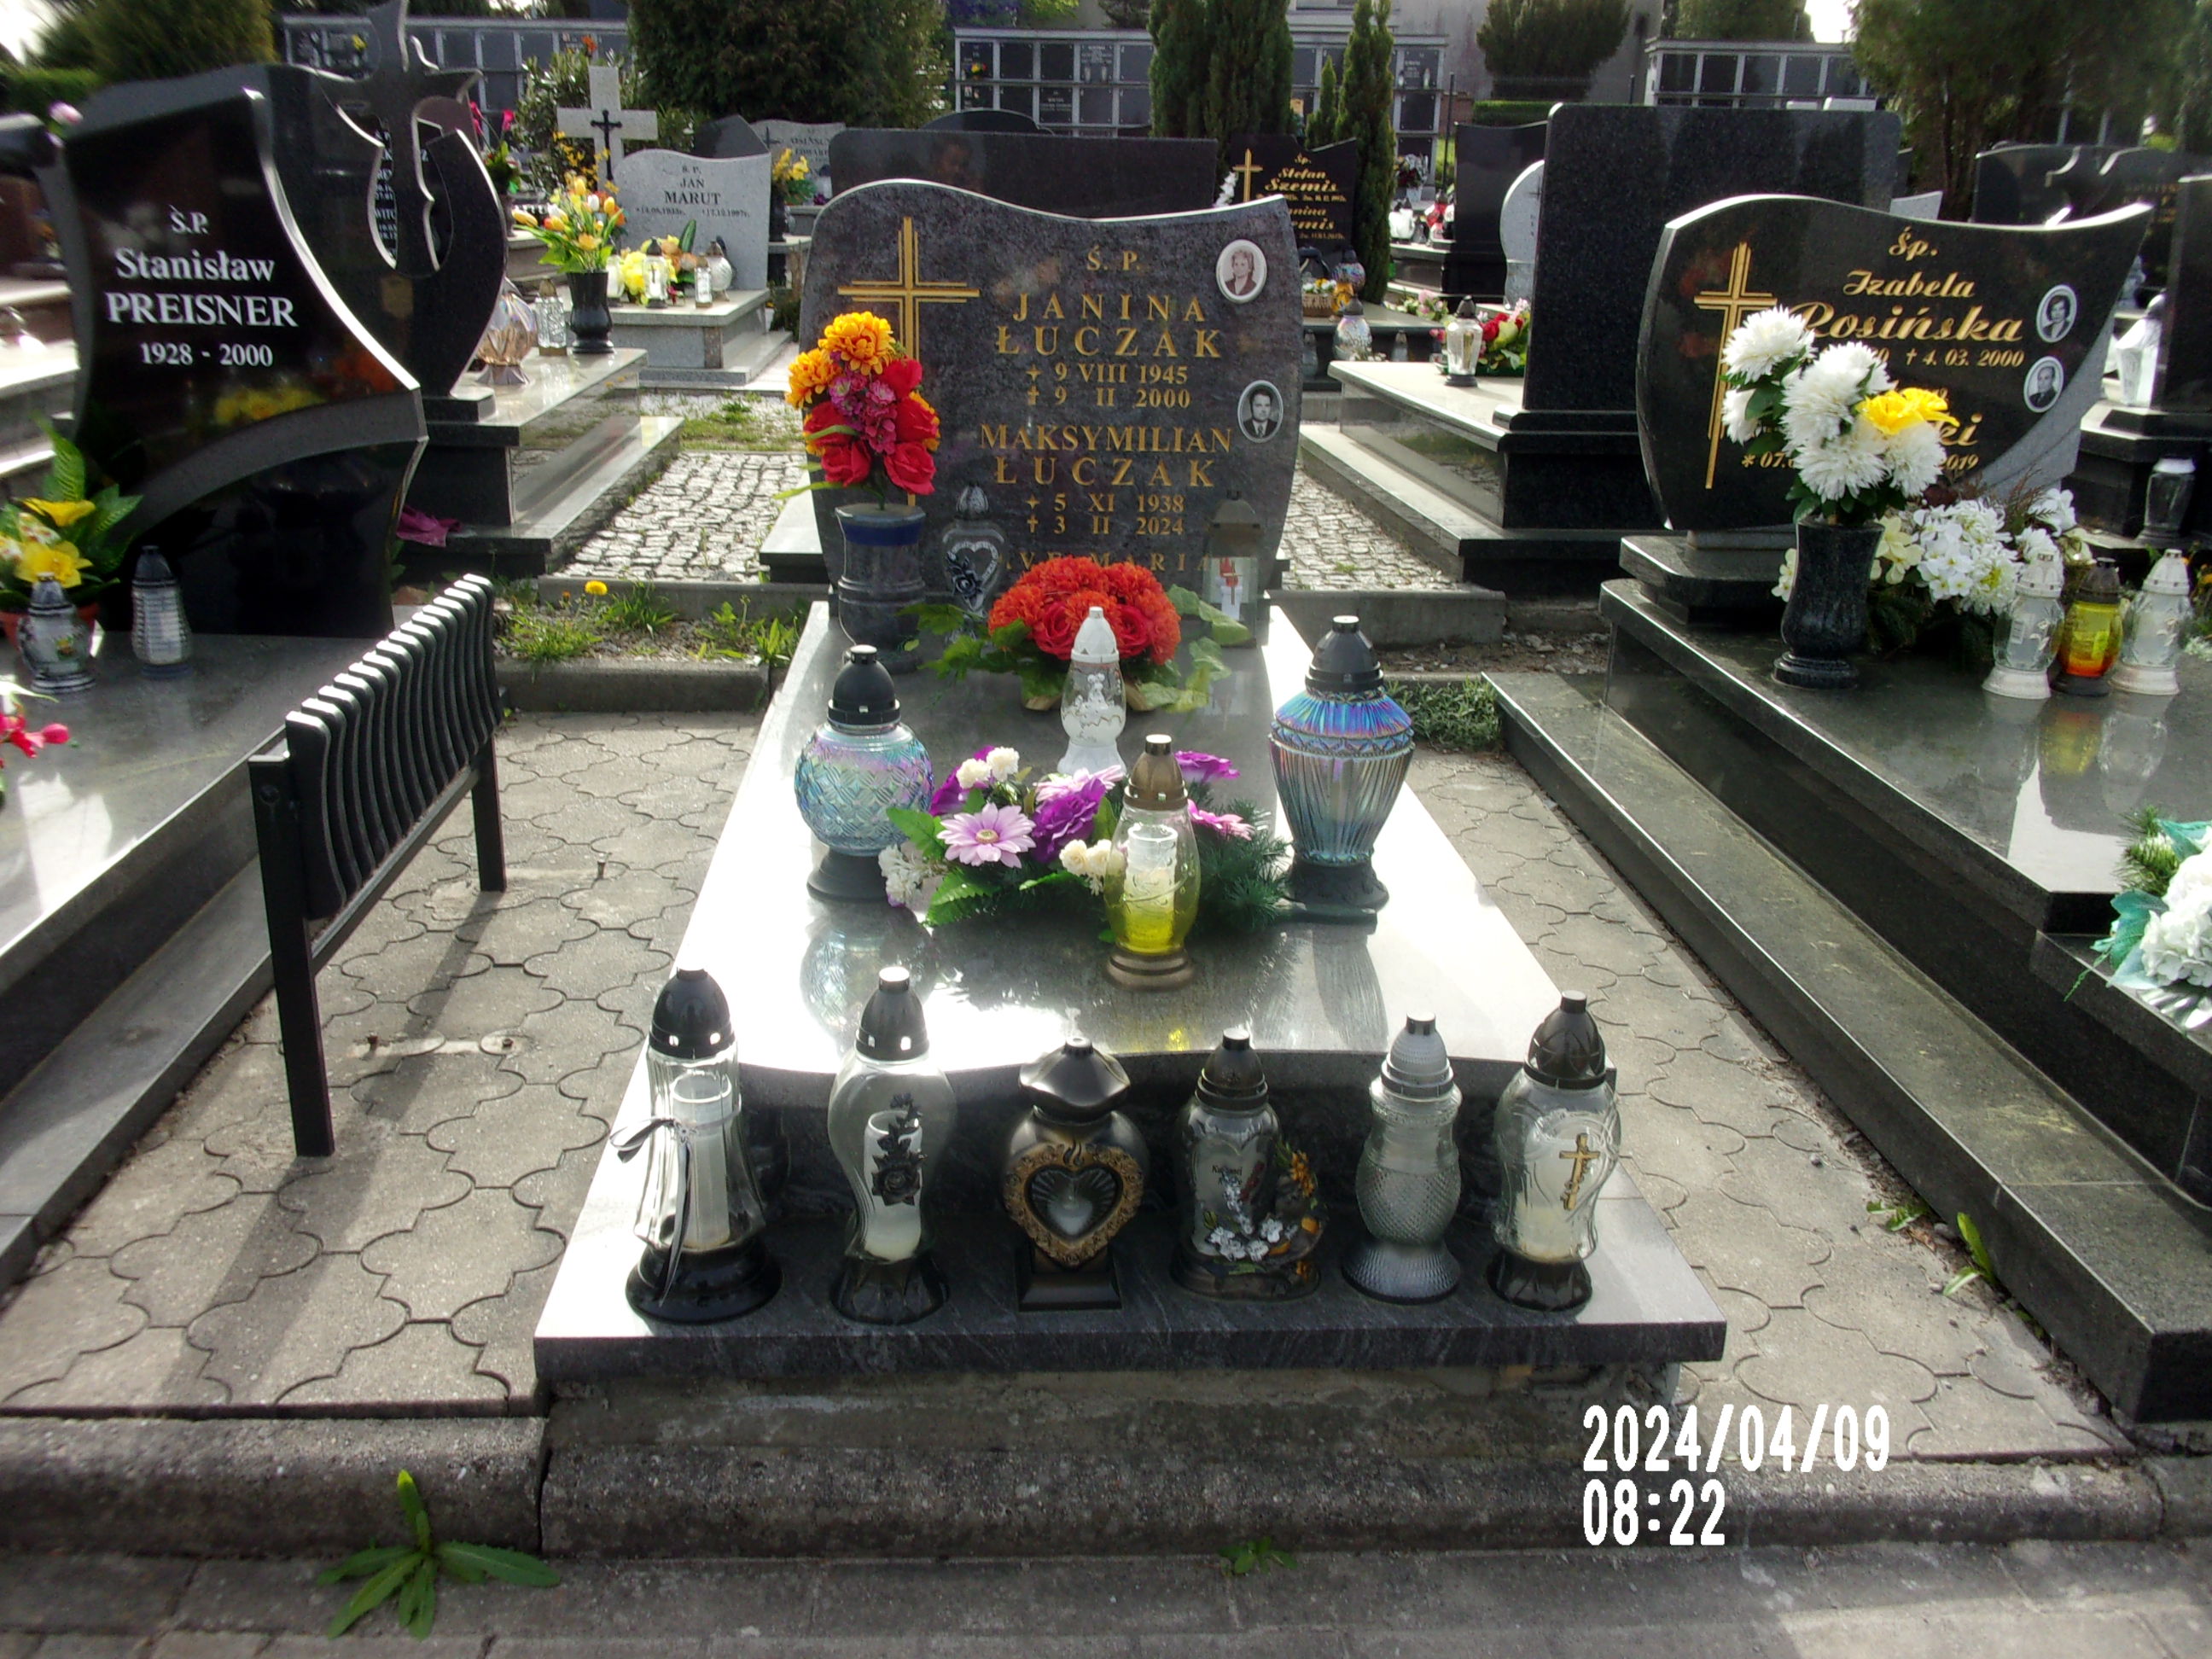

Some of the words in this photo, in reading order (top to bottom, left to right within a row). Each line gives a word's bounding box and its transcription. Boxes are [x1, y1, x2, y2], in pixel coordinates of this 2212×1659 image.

[680, 178, 705, 189] JAN
[1265, 178, 1337, 192] Szemis
[1278, 167, 1326, 180] Stefan
[664, 190, 721, 206] MARUT
[1889, 227, 1938, 261] Śp.
[114, 247, 276, 282] Stanisław
[1086, 246, 1108, 271] Ś.
[1122, 250, 1141, 271] P.
[1843, 268, 1975, 298] Izabela
[104, 292, 300, 328] PREISNER
[1013, 293, 1206, 323] JANINA
[1788, 301, 2024, 342] Rosińska
[140, 342, 194, 365] 1928
[218, 343, 274, 368] 2000
[995, 326, 1222, 359] ŁUCZAK
[1944, 349, 1970, 367] 03.
[1977, 350, 2025, 368] 2000
[1055, 363, 1068, 381] 9
[1077, 364, 1127, 383] VIII
[1138, 365, 1189, 385] 1945
[1055, 387, 1068, 406] 9
[1096, 388, 1115, 407] II
[1134, 389, 1191, 409] 2000
[980, 423, 1234, 454] MAKSYMILIAN
[993, 457, 1216, 488] ŁUCZAK
[1054, 492, 1067, 512] 5
[1088, 493, 1115, 512] XI
[1137, 494, 1185, 513] 1938
[1054, 515, 1067, 534] 3
[1091, 516, 1110, 535] II
[1136, 517, 1185, 536] 2024
